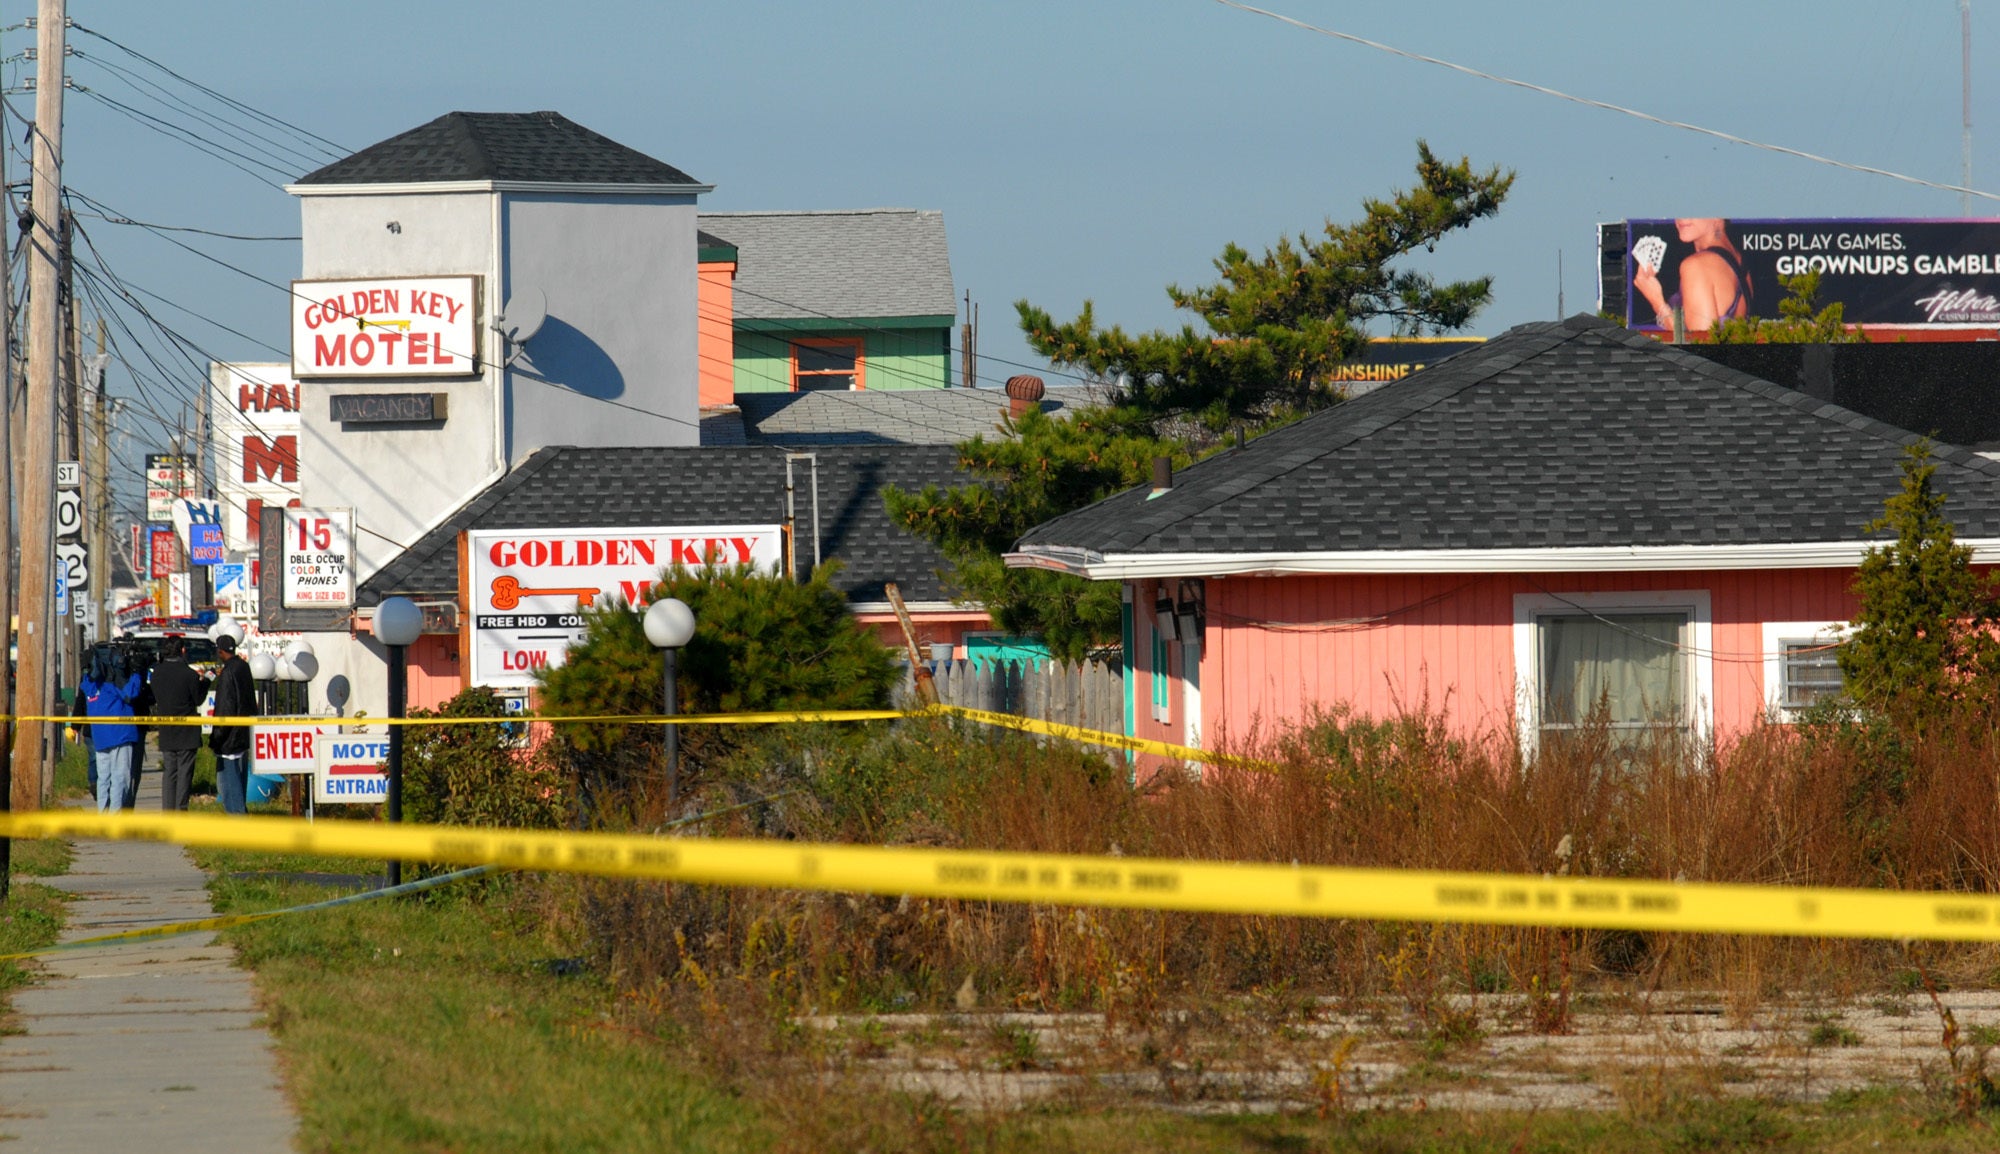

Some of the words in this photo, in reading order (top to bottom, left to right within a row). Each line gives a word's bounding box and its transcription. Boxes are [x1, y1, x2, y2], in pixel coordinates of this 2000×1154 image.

[1743, 233, 1784, 251] KIDS
[1788, 233, 1832, 251] PLAY
[1837, 233, 1906, 251] GAMES.
[1776, 255, 1909, 275] GROWNUPS
[304, 289, 399, 330] GOLDEN
[410, 289, 465, 324] KEY
[1914, 288, 2000, 322] Hilton
[1938, 312, 1970, 321] CASINO
[315, 332, 454, 367] MOTEL
[336, 396, 430, 419] VACANCY
[489, 539, 657, 568] GOLDEN
[669, 537, 760, 565] KEY
[290, 565, 321, 575] COLOR
[330, 565, 345, 574] TV
[297, 576, 339, 586] PHONES
[297, 591, 313, 600] KING
[315, 591, 330, 600] SIZE
[332, 591, 346, 600] BED
[479, 616, 514, 628] FREE
[517, 616, 547, 628] HBO
[503, 650, 547, 671] LOW
[255, 731, 314, 760] ENTER
[332, 743, 390, 758] MOTE
